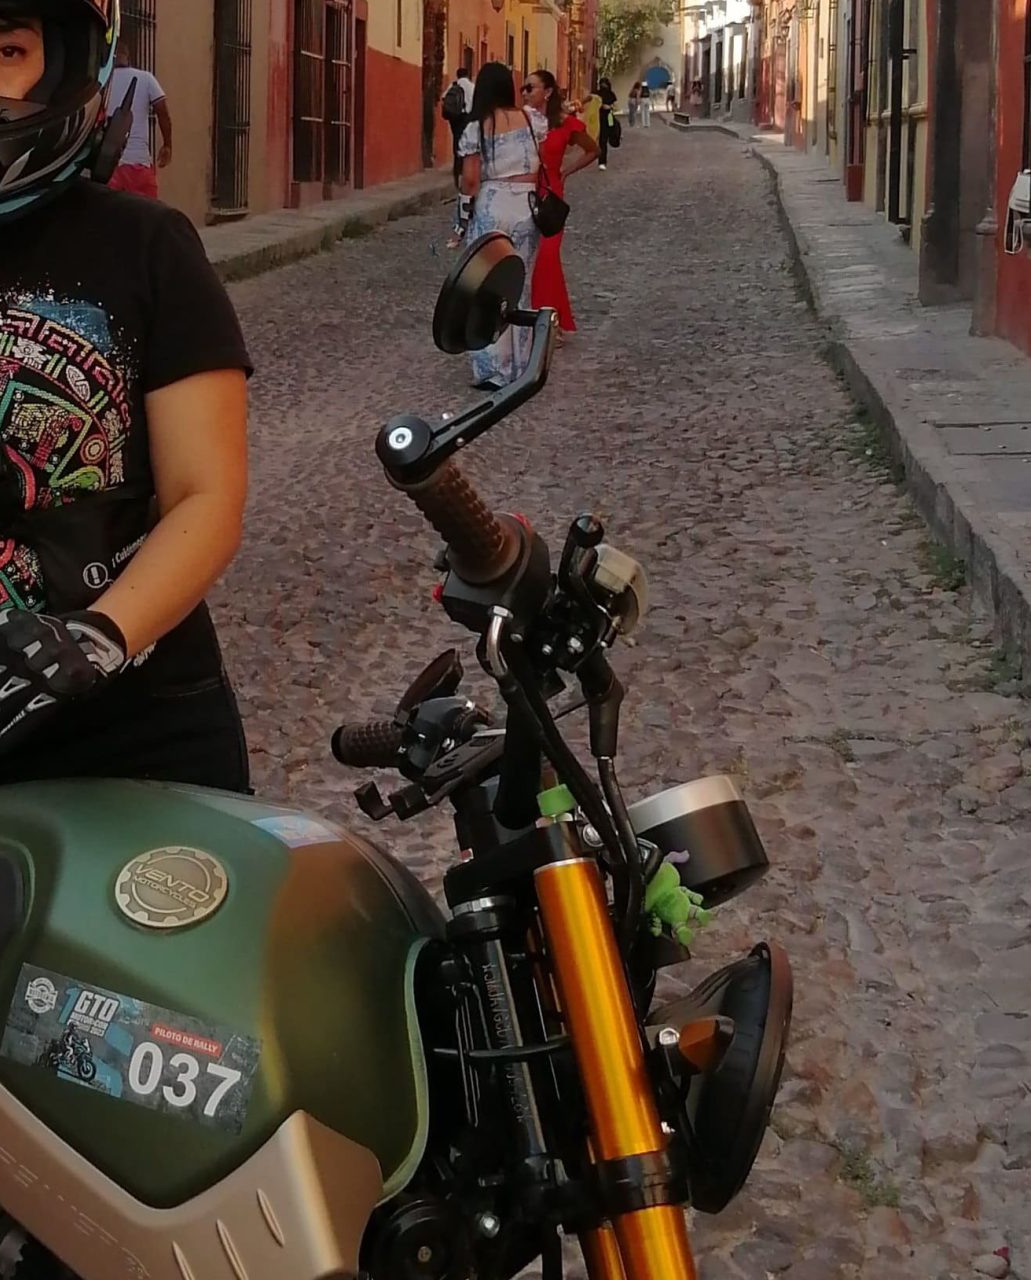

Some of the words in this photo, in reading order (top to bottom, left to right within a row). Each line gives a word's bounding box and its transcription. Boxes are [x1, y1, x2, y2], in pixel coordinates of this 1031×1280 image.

[133, 875, 198, 910] MOTORCYCLES
[135, 864, 210, 903] VENTO
[74, 990, 120, 1023] GTO
[154, 1027, 182, 1042] PILOTO
[182, 1036, 193, 1046] DE
[193, 1039, 219, 1053] RALLY
[129, 1041, 241, 1117] 037
